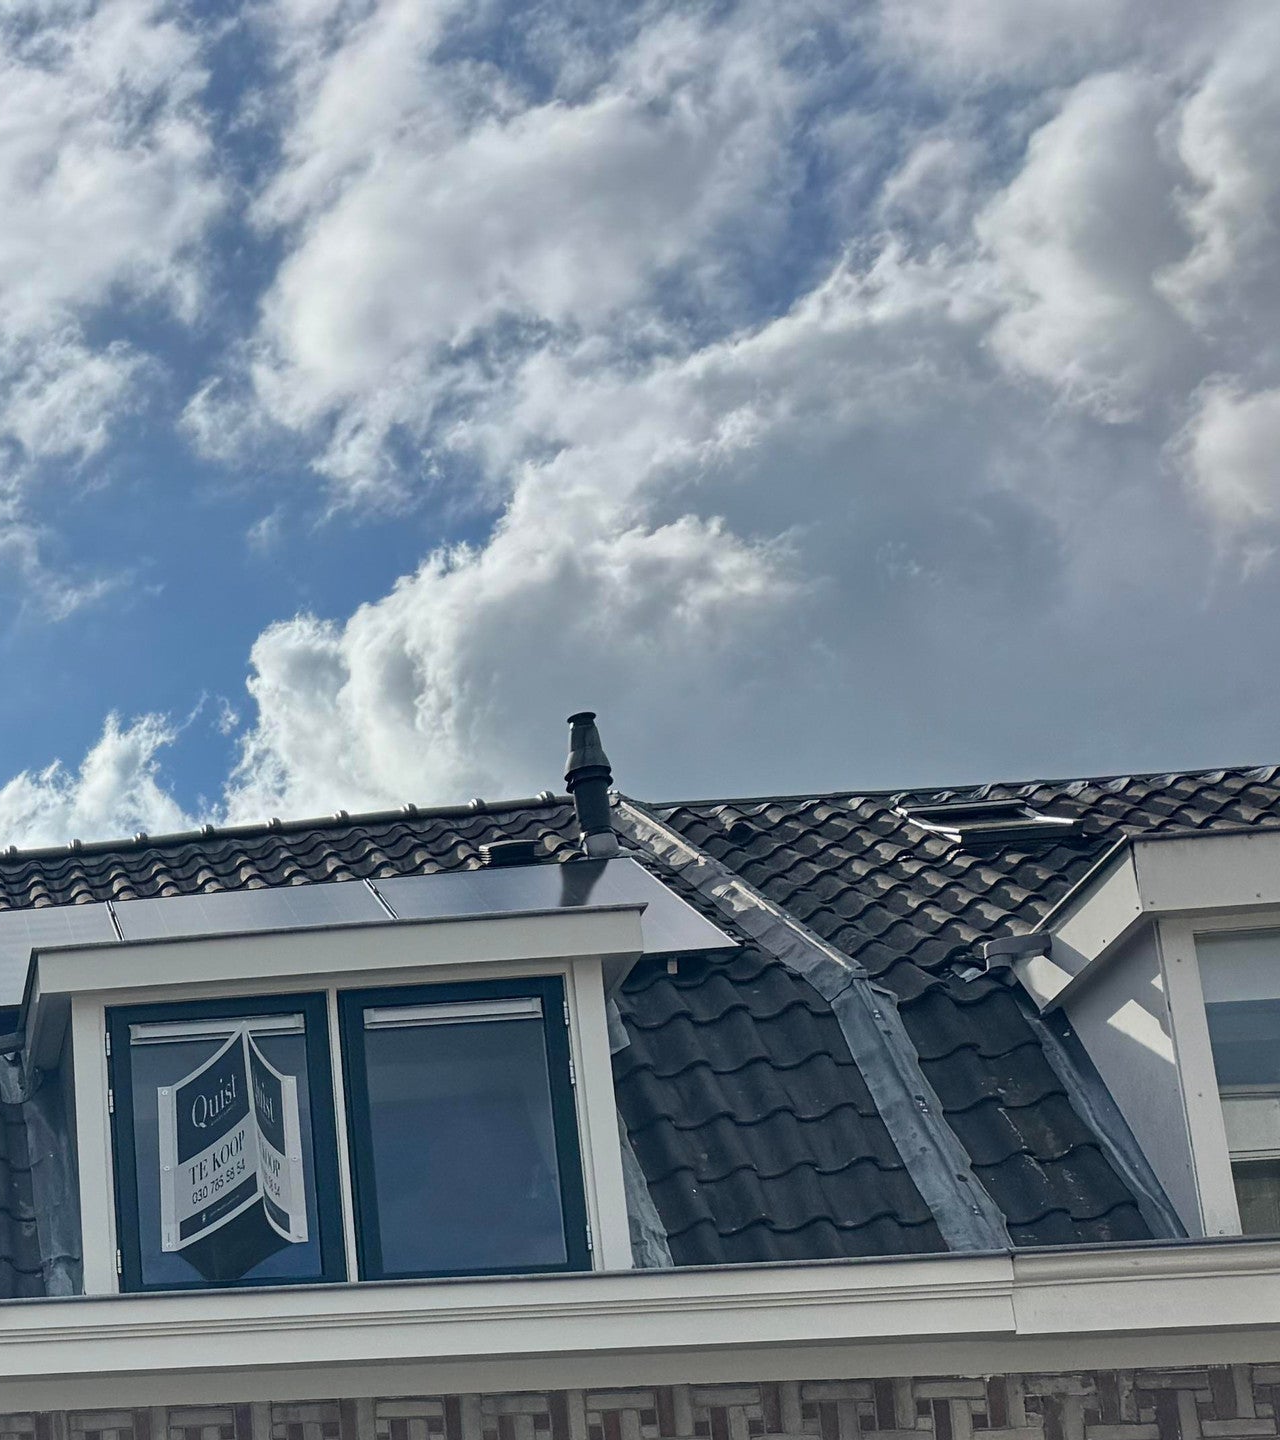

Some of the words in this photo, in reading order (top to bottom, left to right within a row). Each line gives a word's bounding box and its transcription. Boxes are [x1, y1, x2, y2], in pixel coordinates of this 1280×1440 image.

[191, 1073, 237, 1129] Quist
[188, 1158, 209, 1185] TE
[212, 1130, 245, 1172] KOOP
[192, 1185, 208, 1205] 030
